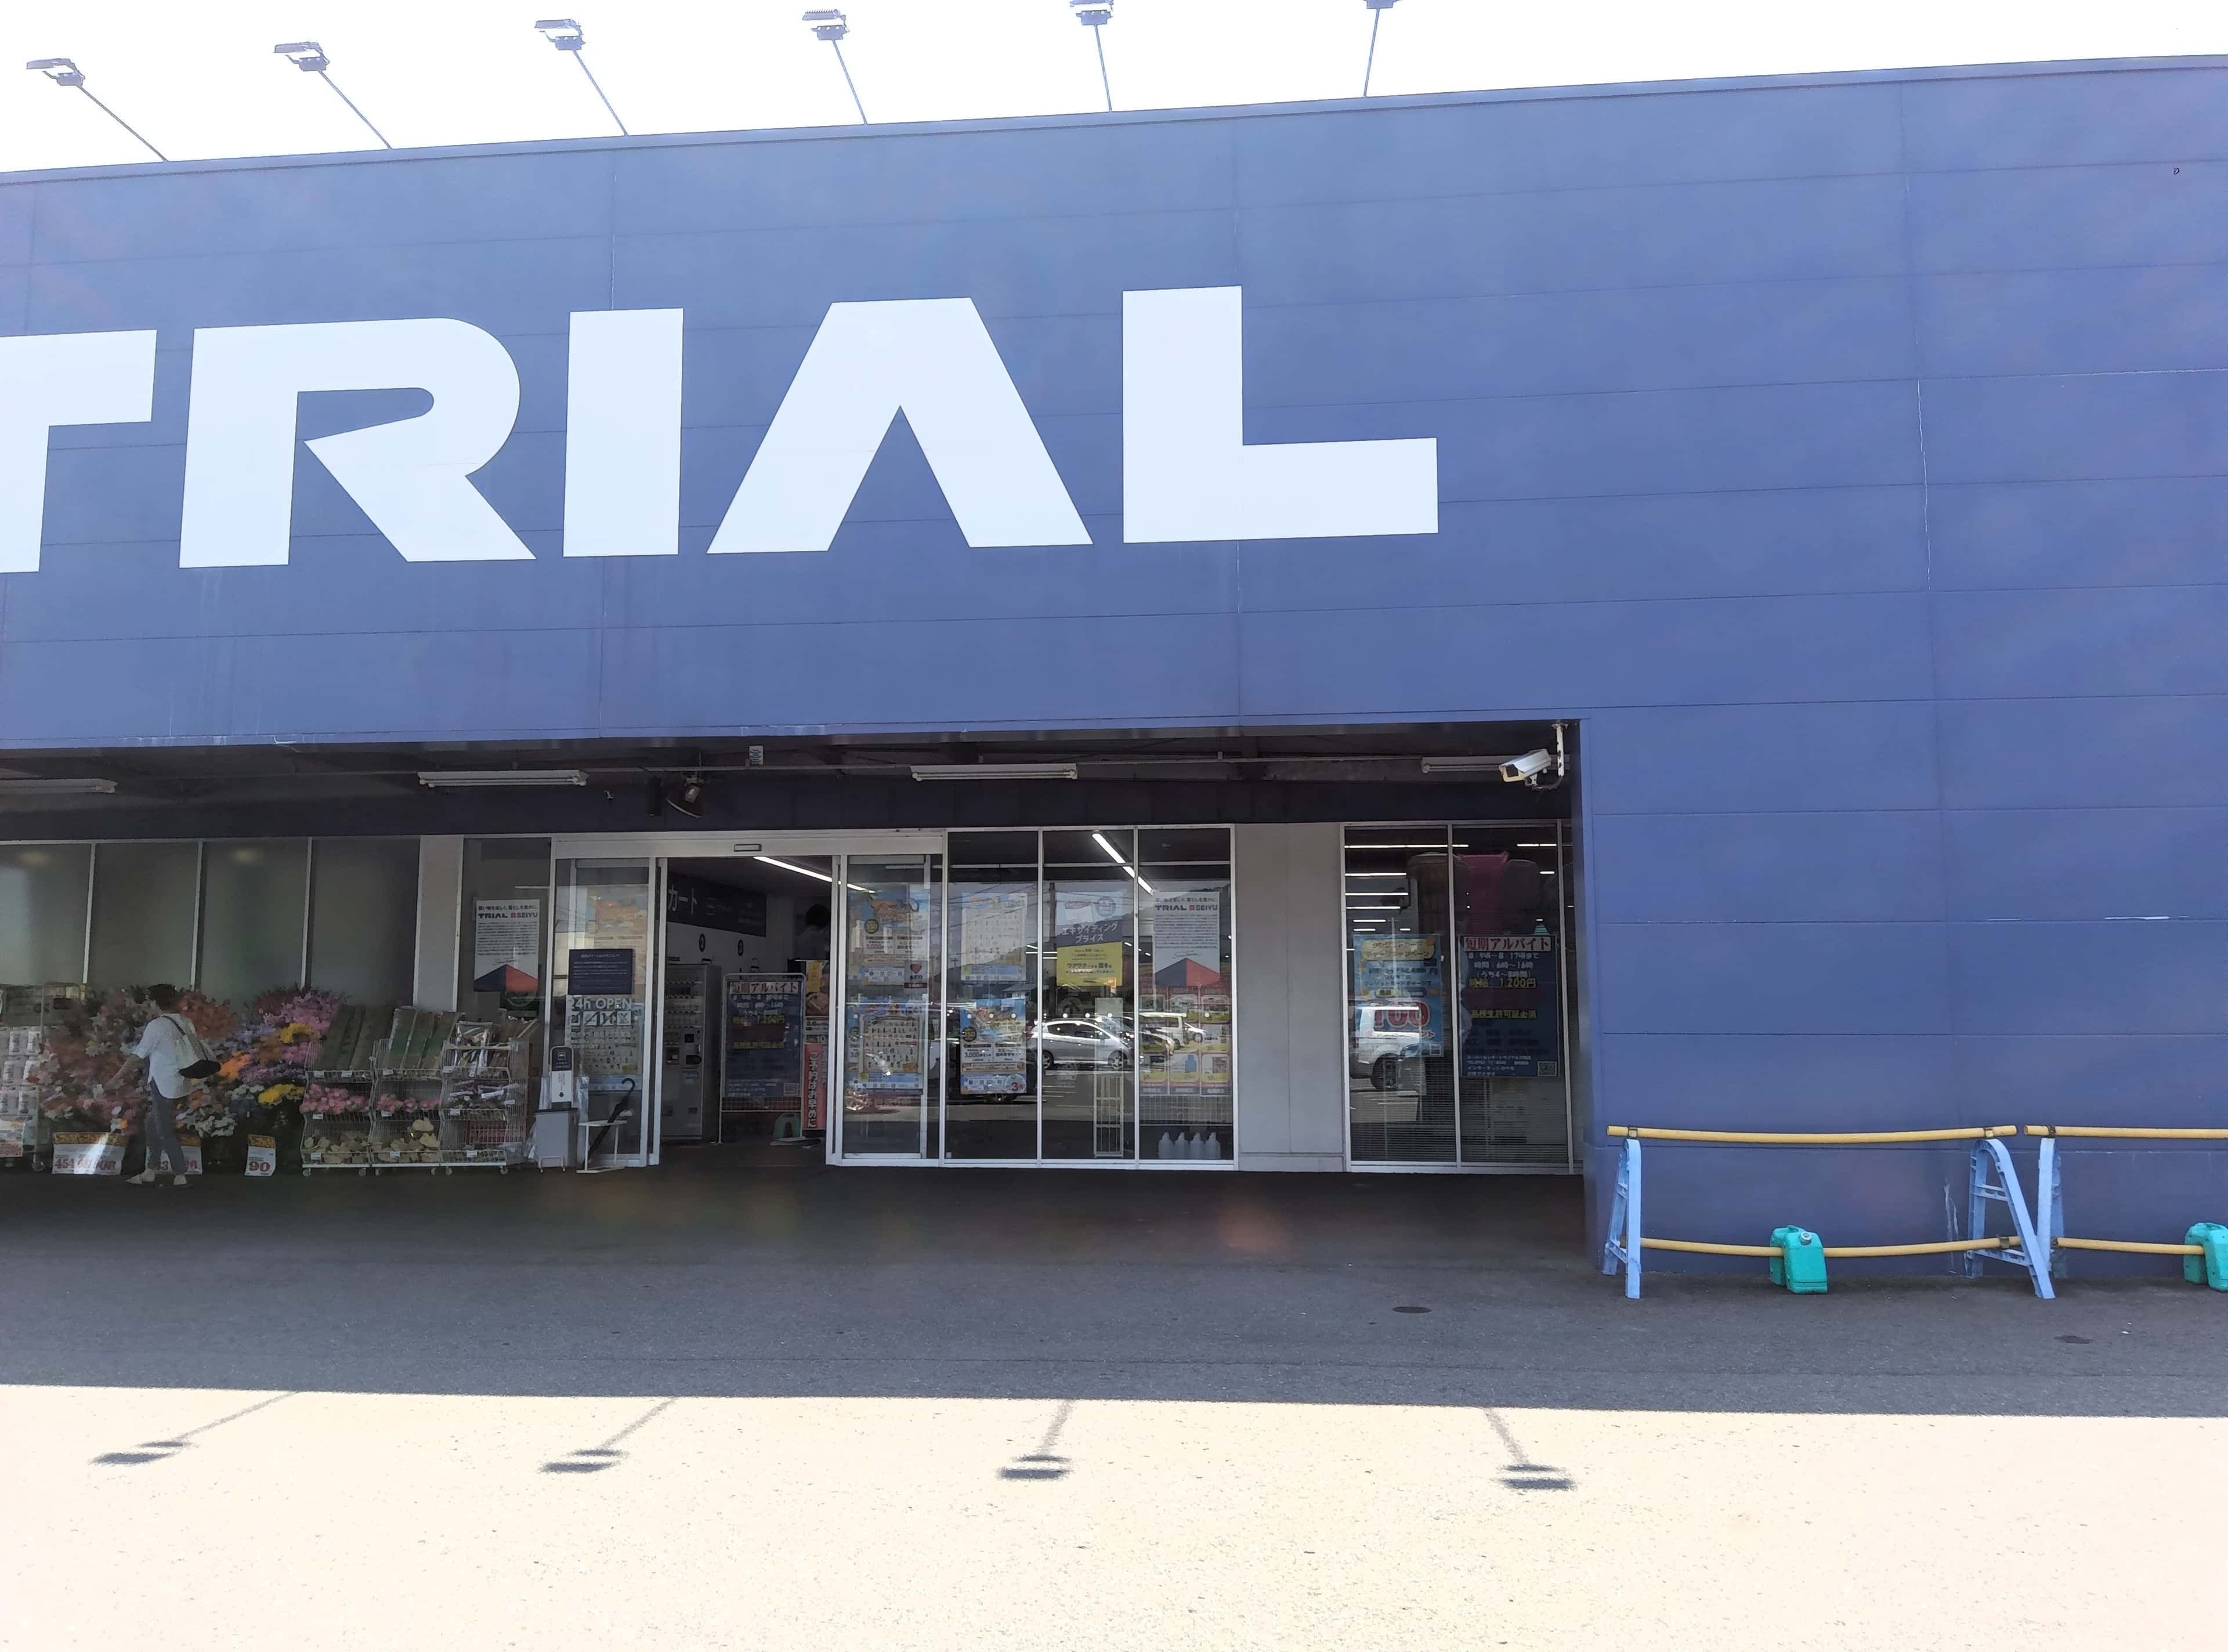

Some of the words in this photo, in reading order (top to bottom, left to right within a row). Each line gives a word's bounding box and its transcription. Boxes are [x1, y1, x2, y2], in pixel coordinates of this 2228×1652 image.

[1062, 921, 1118, 935] エキサイティング
[1075, 934, 1104, 944] プライス
[1466, 937, 1549, 950] 短期アルバイト
[595, 997, 632, 1010] OPEN
[807, 1051, 819, 1128] ご予約はお早めに
[249, 1161, 270, 1172] 90
